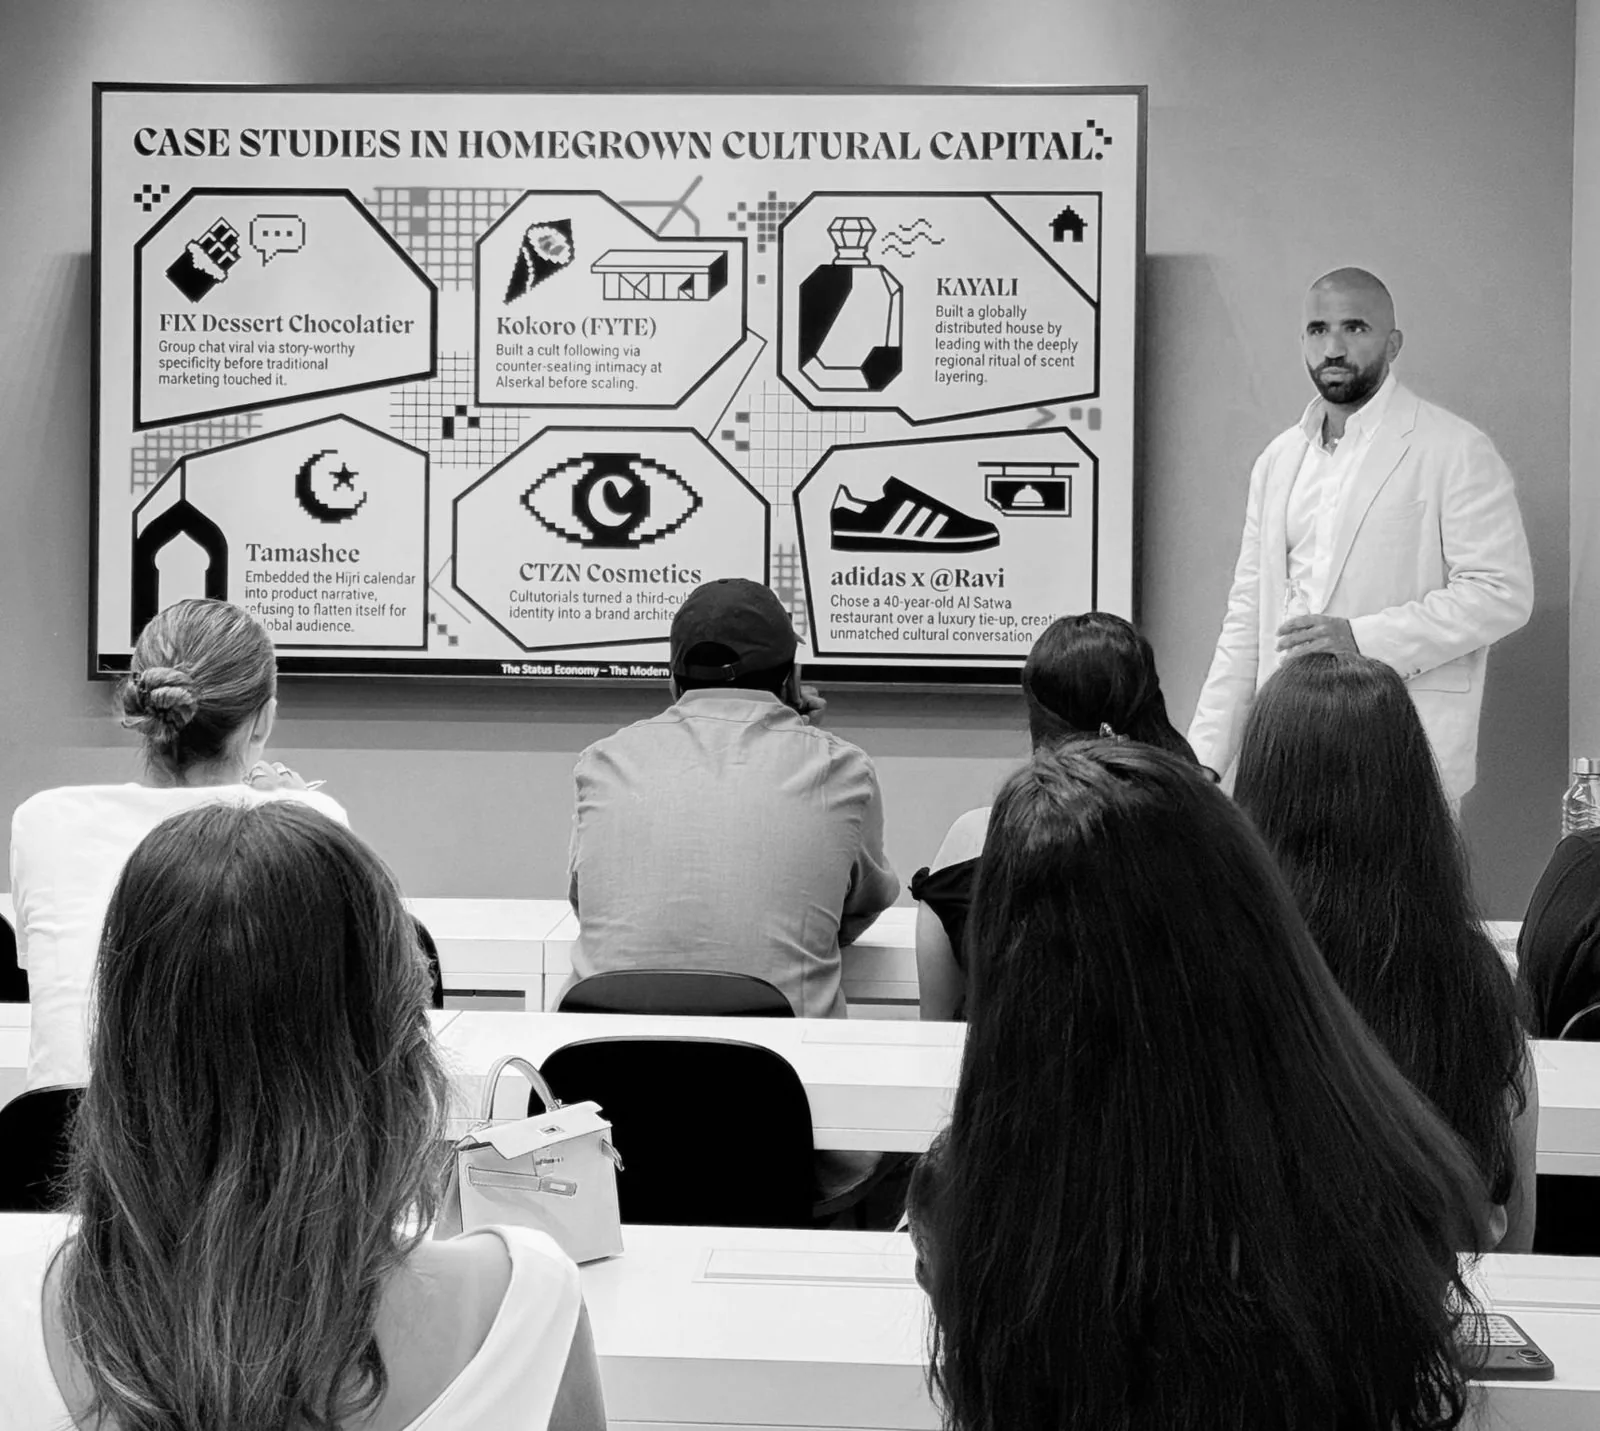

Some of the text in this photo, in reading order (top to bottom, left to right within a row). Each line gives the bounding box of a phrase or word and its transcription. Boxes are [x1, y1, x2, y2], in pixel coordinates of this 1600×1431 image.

[134, 128, 230, 157] CASE
[240, 128, 400, 158] STUDIES
[410, 130, 447, 158] IN
[458, 130, 711, 160] HOMEGROWN
[722, 131, 920, 160] CULTURAL
[937, 278, 1018, 296] KAYALI
[936, 304, 1027, 322] Built a globally
[160, 314, 414, 334] FIX Dessert Chocolatier
[497, 316, 656, 339] Kokoro (FYTE)
[935, 321, 1062, 337] distributed house by
[159, 340, 355, 356] Group chat viral via story-worthy
[496, 344, 640, 359] Built a cult following via
[936, 338, 1078, 354] leading with the deeply
[159, 355, 328, 371] specificity before traditional
[496, 361, 661, 376] counter-seating intimacy at
[935, 354, 1074, 370] regional ritual of scent
[159, 372, 287, 387] marketing touched it.
[496, 376, 637, 392] Alserkal before scaling.
[935, 371, 987, 386] layering.
[246, 543, 360, 563] Tamashee
[246, 570, 415, 586] Embedded the Hijri calendar
[519, 563, 702, 584] CTZN Cosmetics
[831, 566, 1004, 592] adidas x @Ravi
[245, 586, 377, 601] into product narrative,
[510, 590, 690, 605] Cultutorials turned a third-cul
[245, 602, 406, 618] efusing to flatten itself for
[831, 594, 1012, 611] Chose a 40-year-old Al Satwa
[510, 606, 678, 622] identity into a brand archite
[831, 612, 893, 624] restaurant
[897, 614, 923, 624] over
[927, 615, 934, 624] a
[938, 612, 975, 628] luxury
[979, 613, 1017, 628] tie-up,
[263, 618, 354, 632] obal audience.
[830, 627, 1032, 642] unmatched cultural conversation
[501, 664, 520, 674] The
[522, 664, 552, 674] Status
[553, 665, 599, 677] Economy
[610, 666, 628, 675] The
[630, 666, 669, 676] Modern
